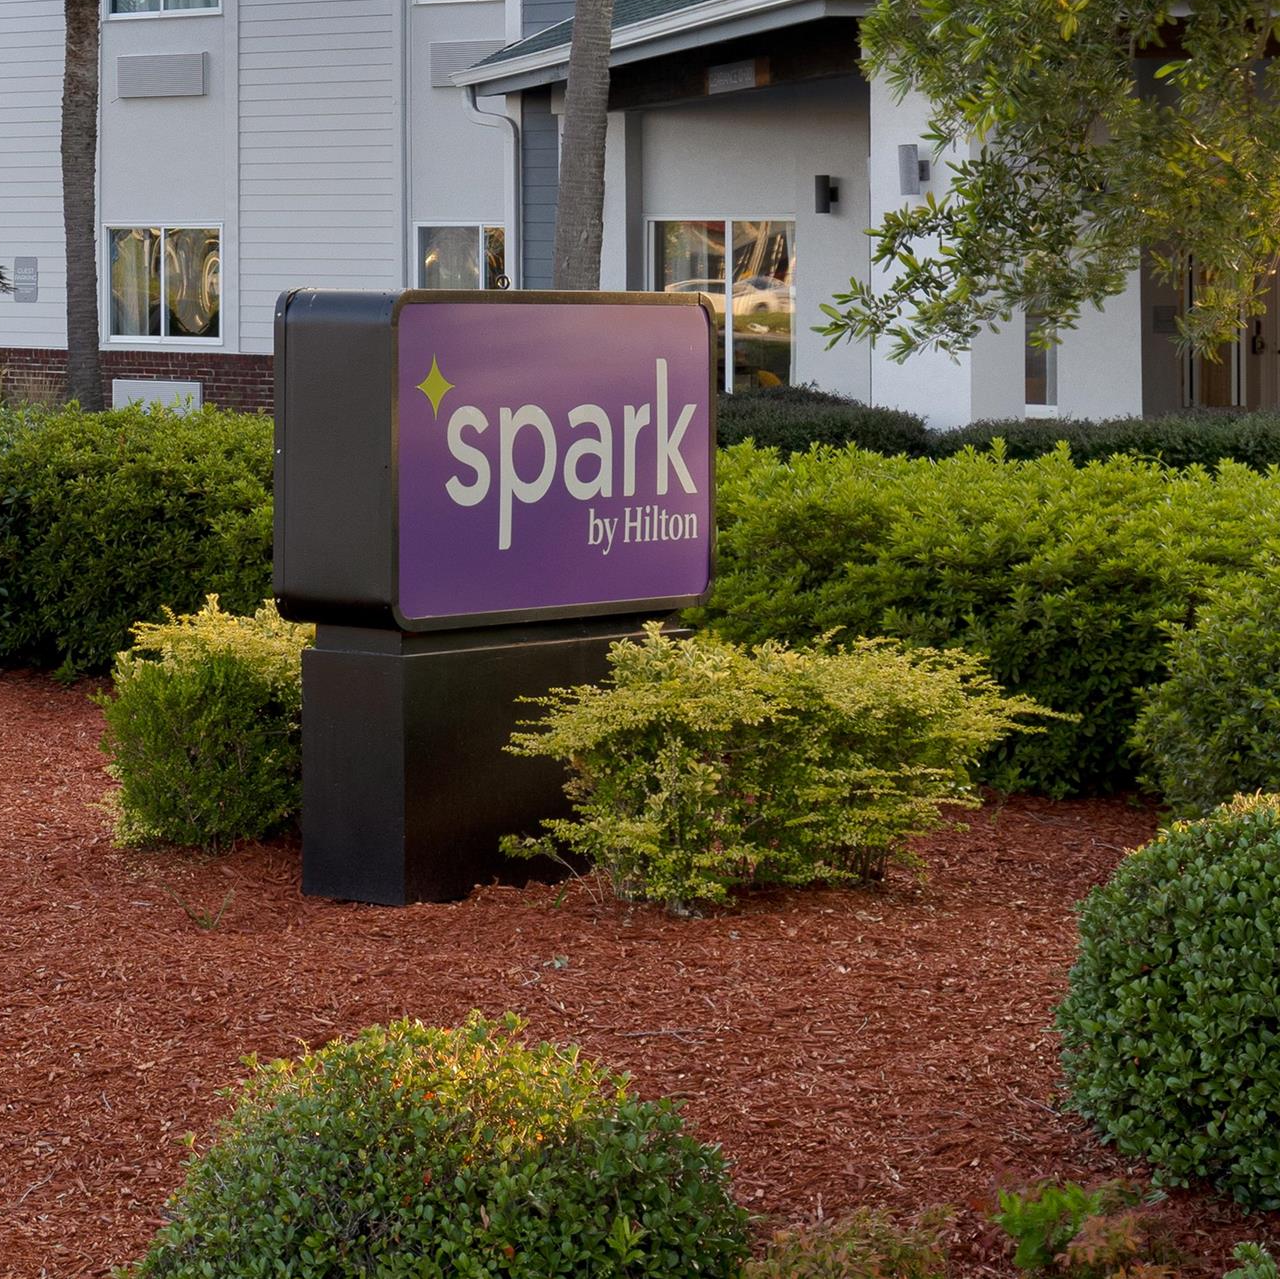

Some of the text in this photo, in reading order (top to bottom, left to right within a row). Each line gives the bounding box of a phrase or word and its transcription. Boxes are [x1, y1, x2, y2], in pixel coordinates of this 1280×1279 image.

[445, 358, 698, 550] spark
[587, 505, 698, 556] by Hilton
